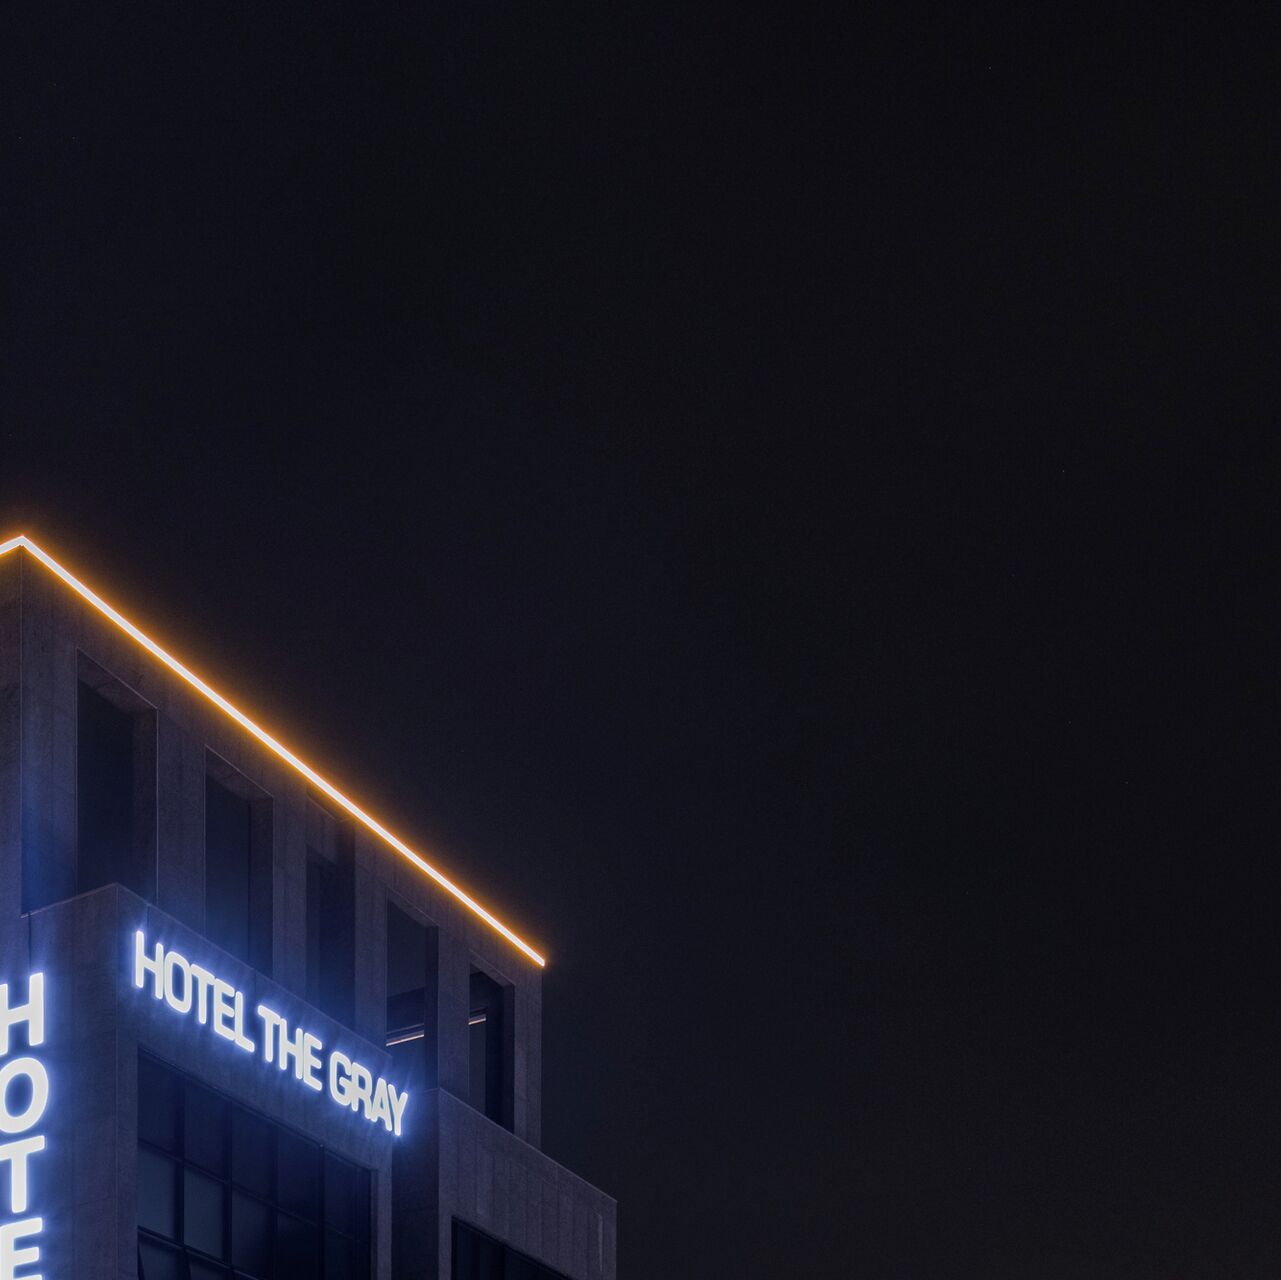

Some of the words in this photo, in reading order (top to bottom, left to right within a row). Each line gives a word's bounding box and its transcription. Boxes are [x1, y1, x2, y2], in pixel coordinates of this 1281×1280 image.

[135, 929, 255, 1053] HOTEL
[257, 1004, 323, 1091] THE
[329, 1051, 409, 1137] GRAY
